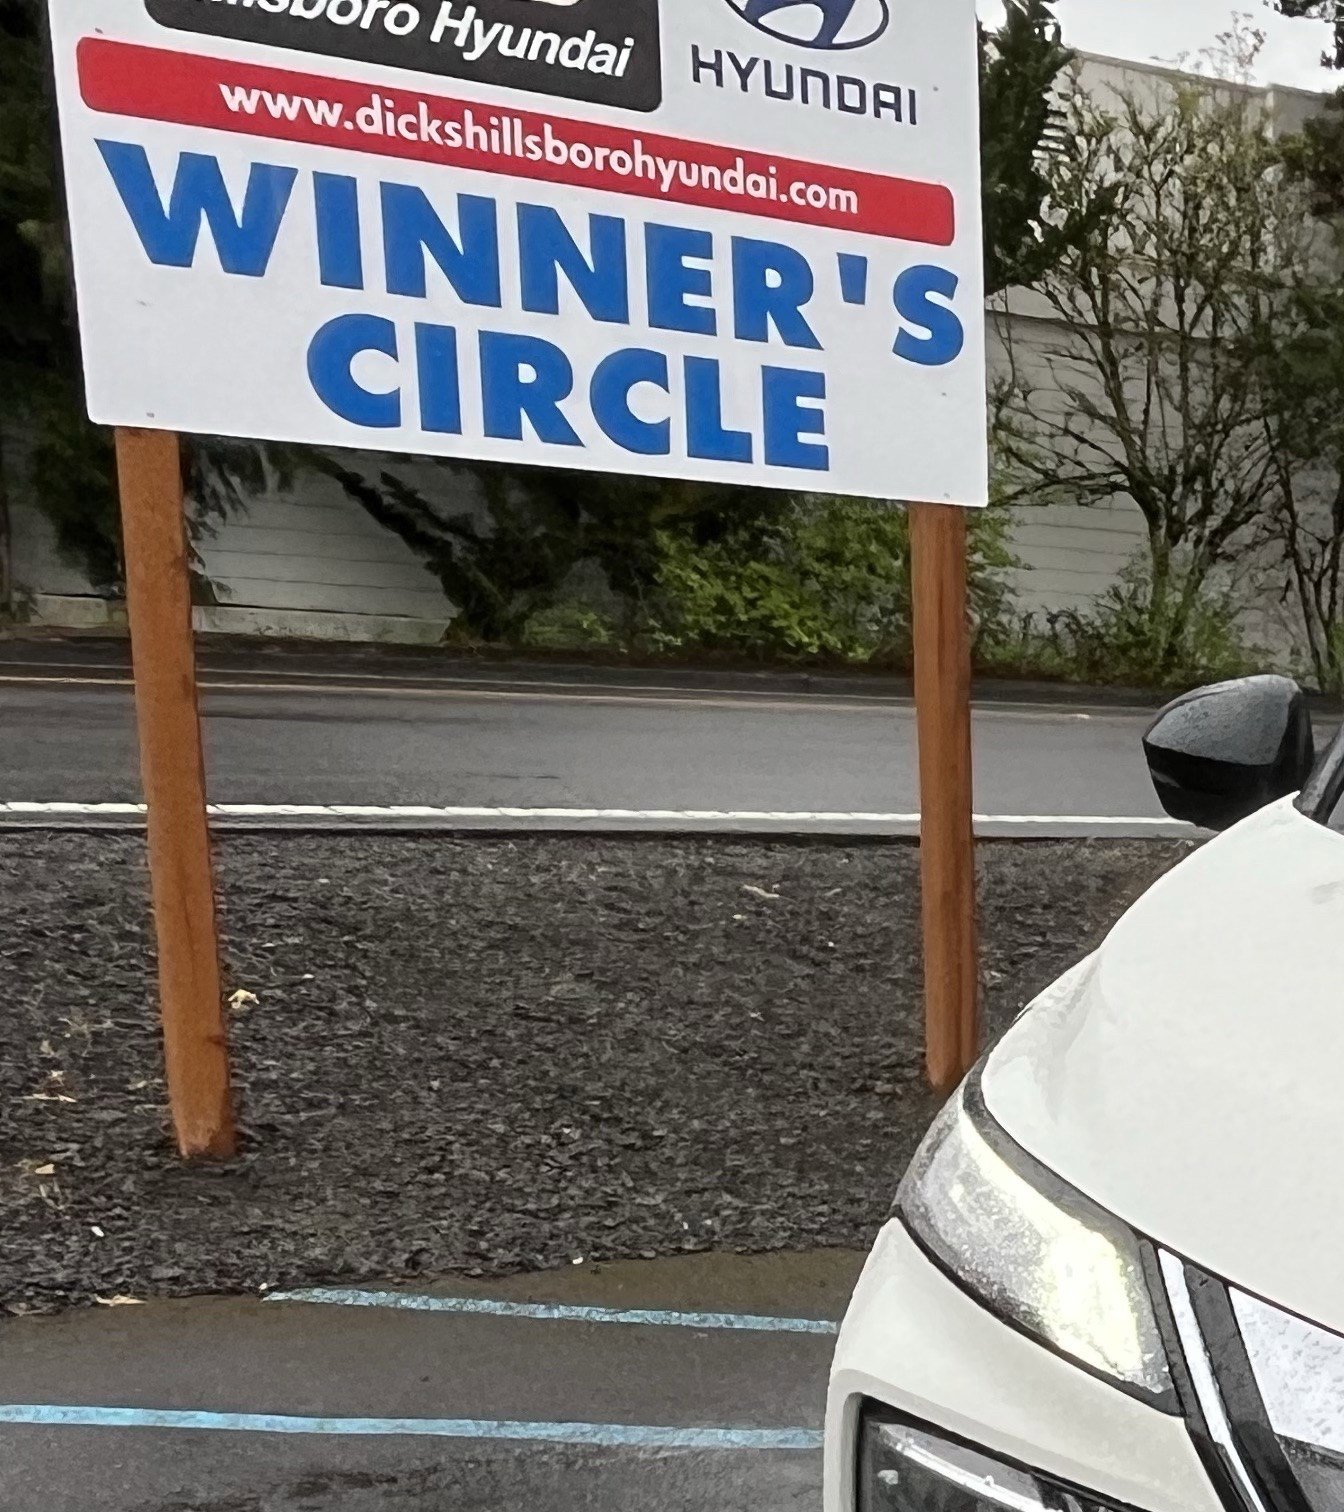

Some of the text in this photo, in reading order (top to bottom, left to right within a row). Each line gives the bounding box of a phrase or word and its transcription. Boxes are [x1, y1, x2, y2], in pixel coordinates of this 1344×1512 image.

[430, 0, 635, 78] Hyundai
[691, 43, 917, 126] HYUNDAI
[218, 81, 859, 215] www.dickshillsborohyundai.com
[94, 138, 965, 368] WINNER'S
[306, 312, 830, 473] CIRCLE
